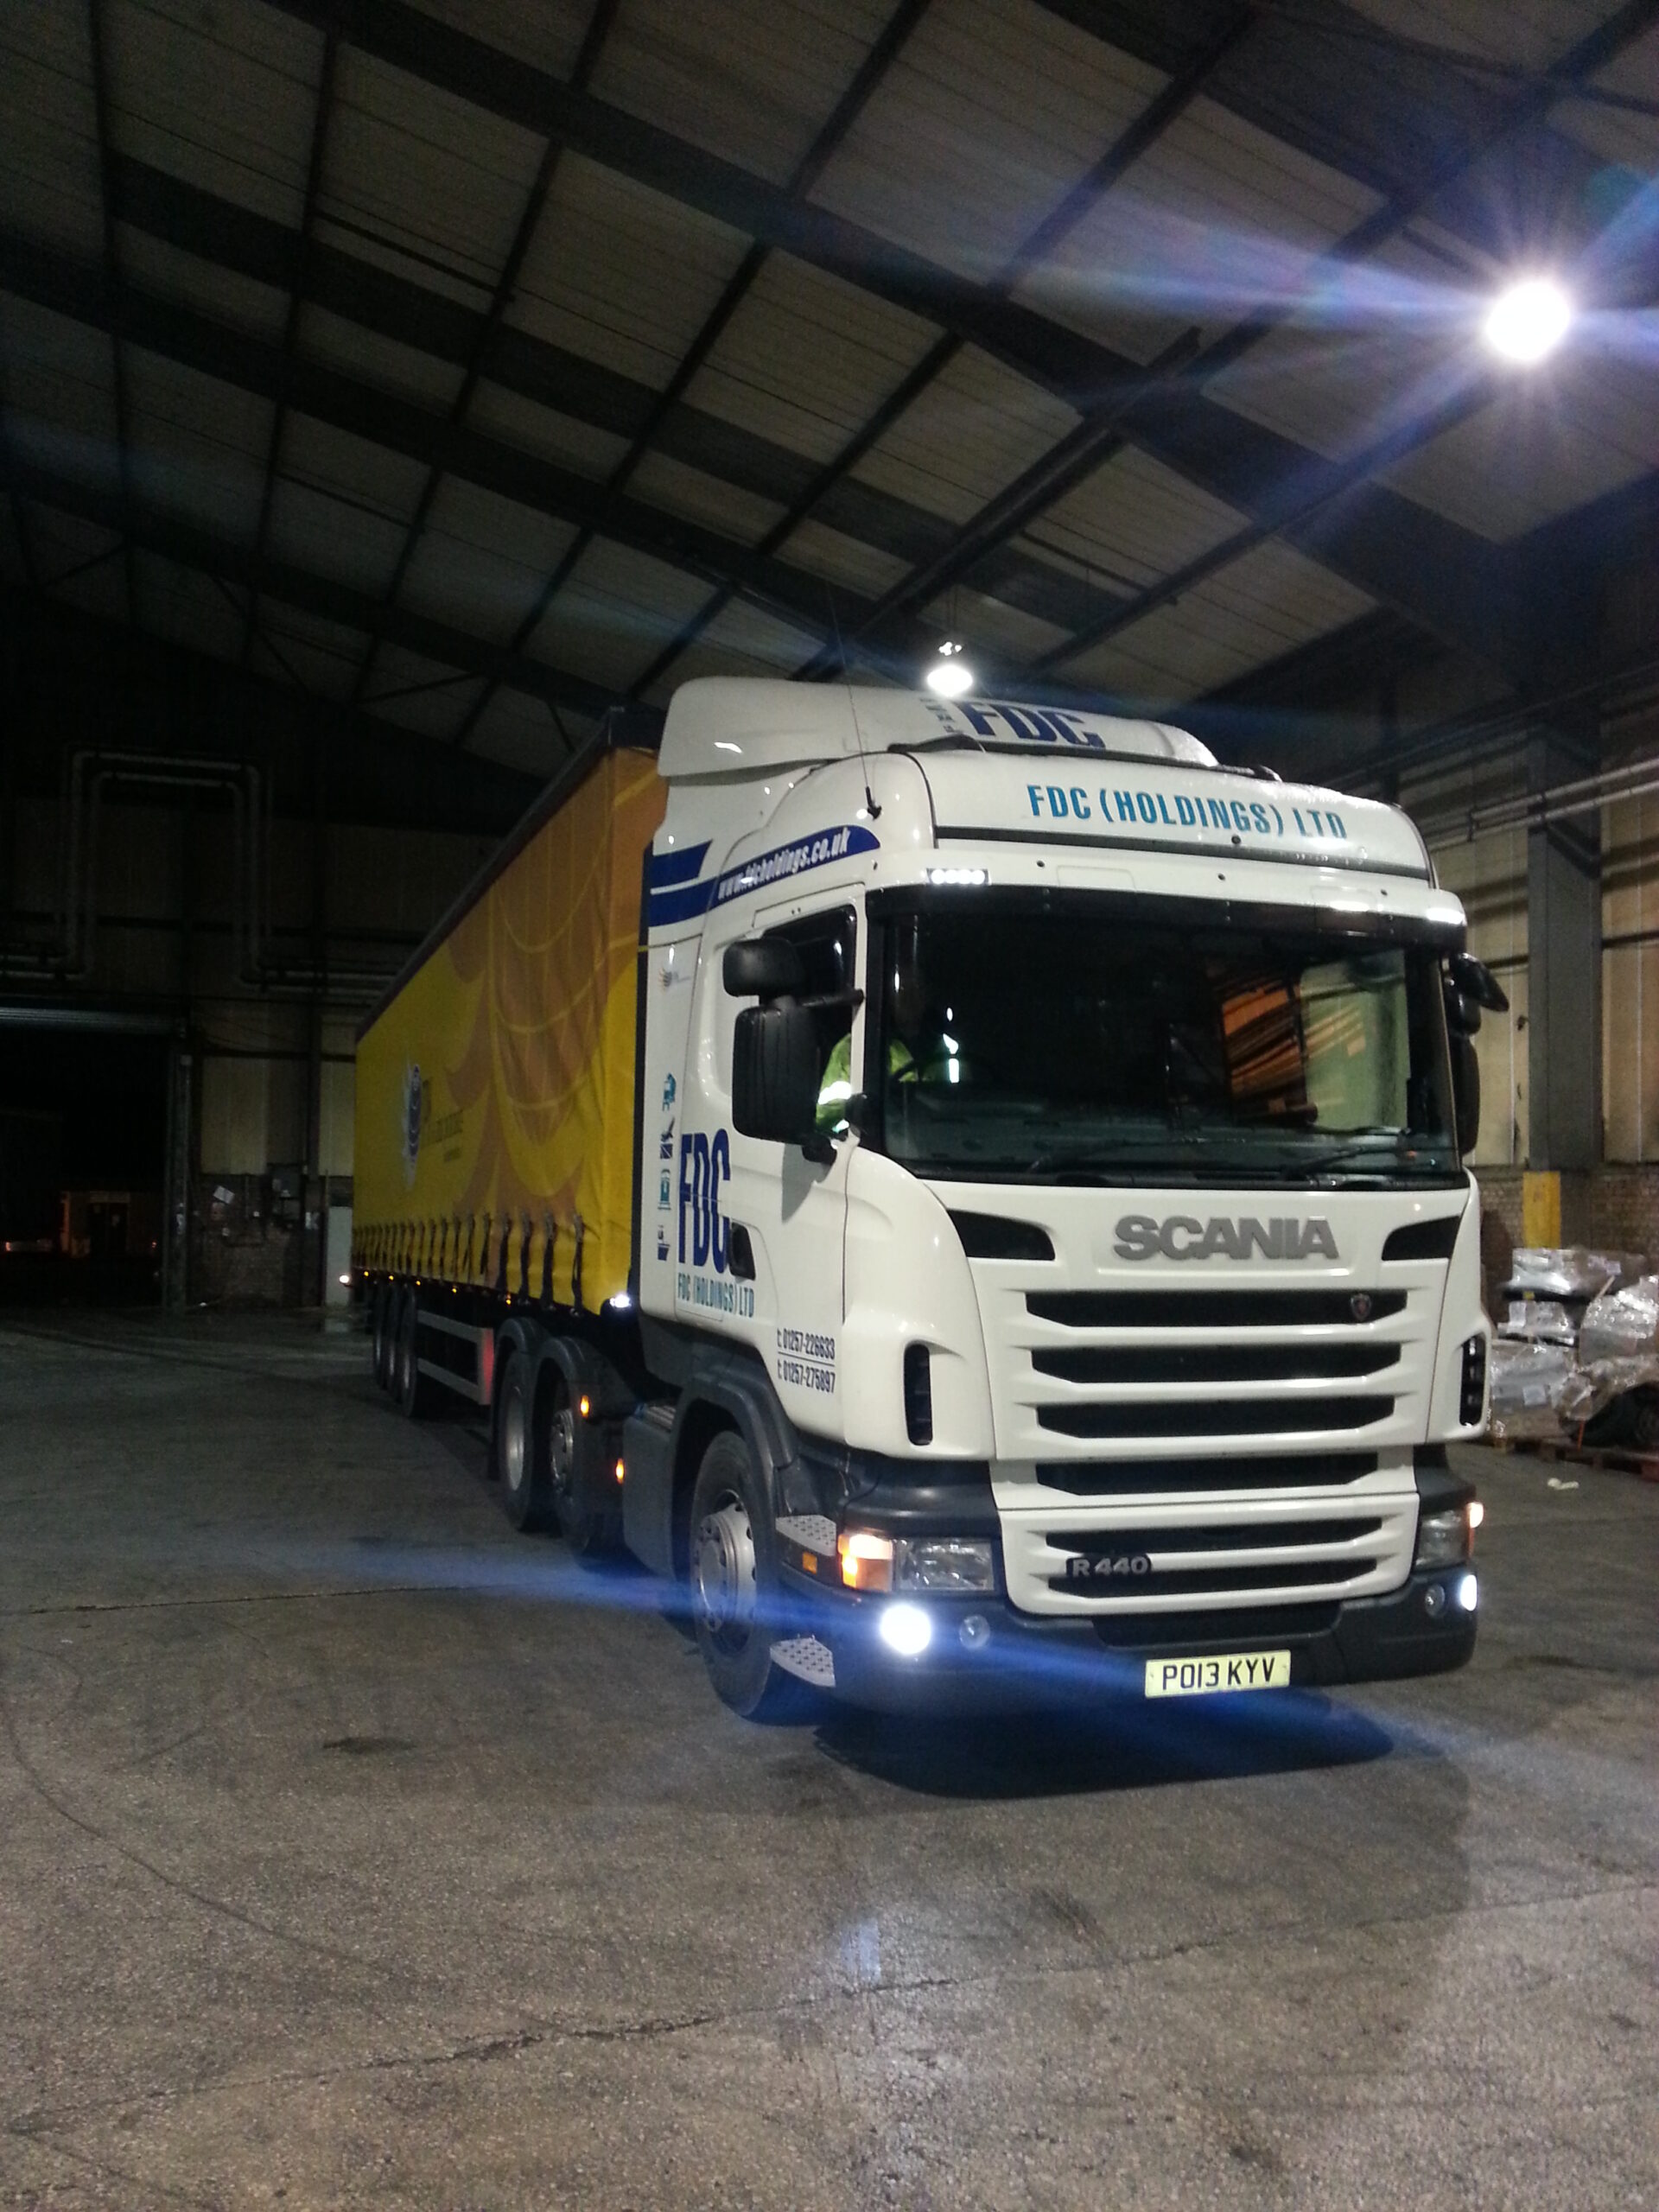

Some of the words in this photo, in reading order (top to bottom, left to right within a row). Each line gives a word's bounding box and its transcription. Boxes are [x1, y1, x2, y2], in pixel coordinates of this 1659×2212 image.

[951, 701, 1106, 749] FDC
[1026, 784, 1091, 820] FDC
[1099, 787, 1284, 836] (HOLDINGS)
[1293, 806, 1348, 839] LTD
[678, 1128, 731, 1274] FDC
[1113, 1215, 1340, 1261] SCANIA
[677, 1272, 691, 1302] FDC
[693, 1274, 737, 1314] (HOLDINGS)
[739, 1283, 755, 1319] LTD
[1072, 1558, 1090, 1577] R
[1093, 1555, 1149, 1576] 440
[1162, 1662, 1220, 1691] PO13
[1228, 1656, 1275, 1686] KYV
